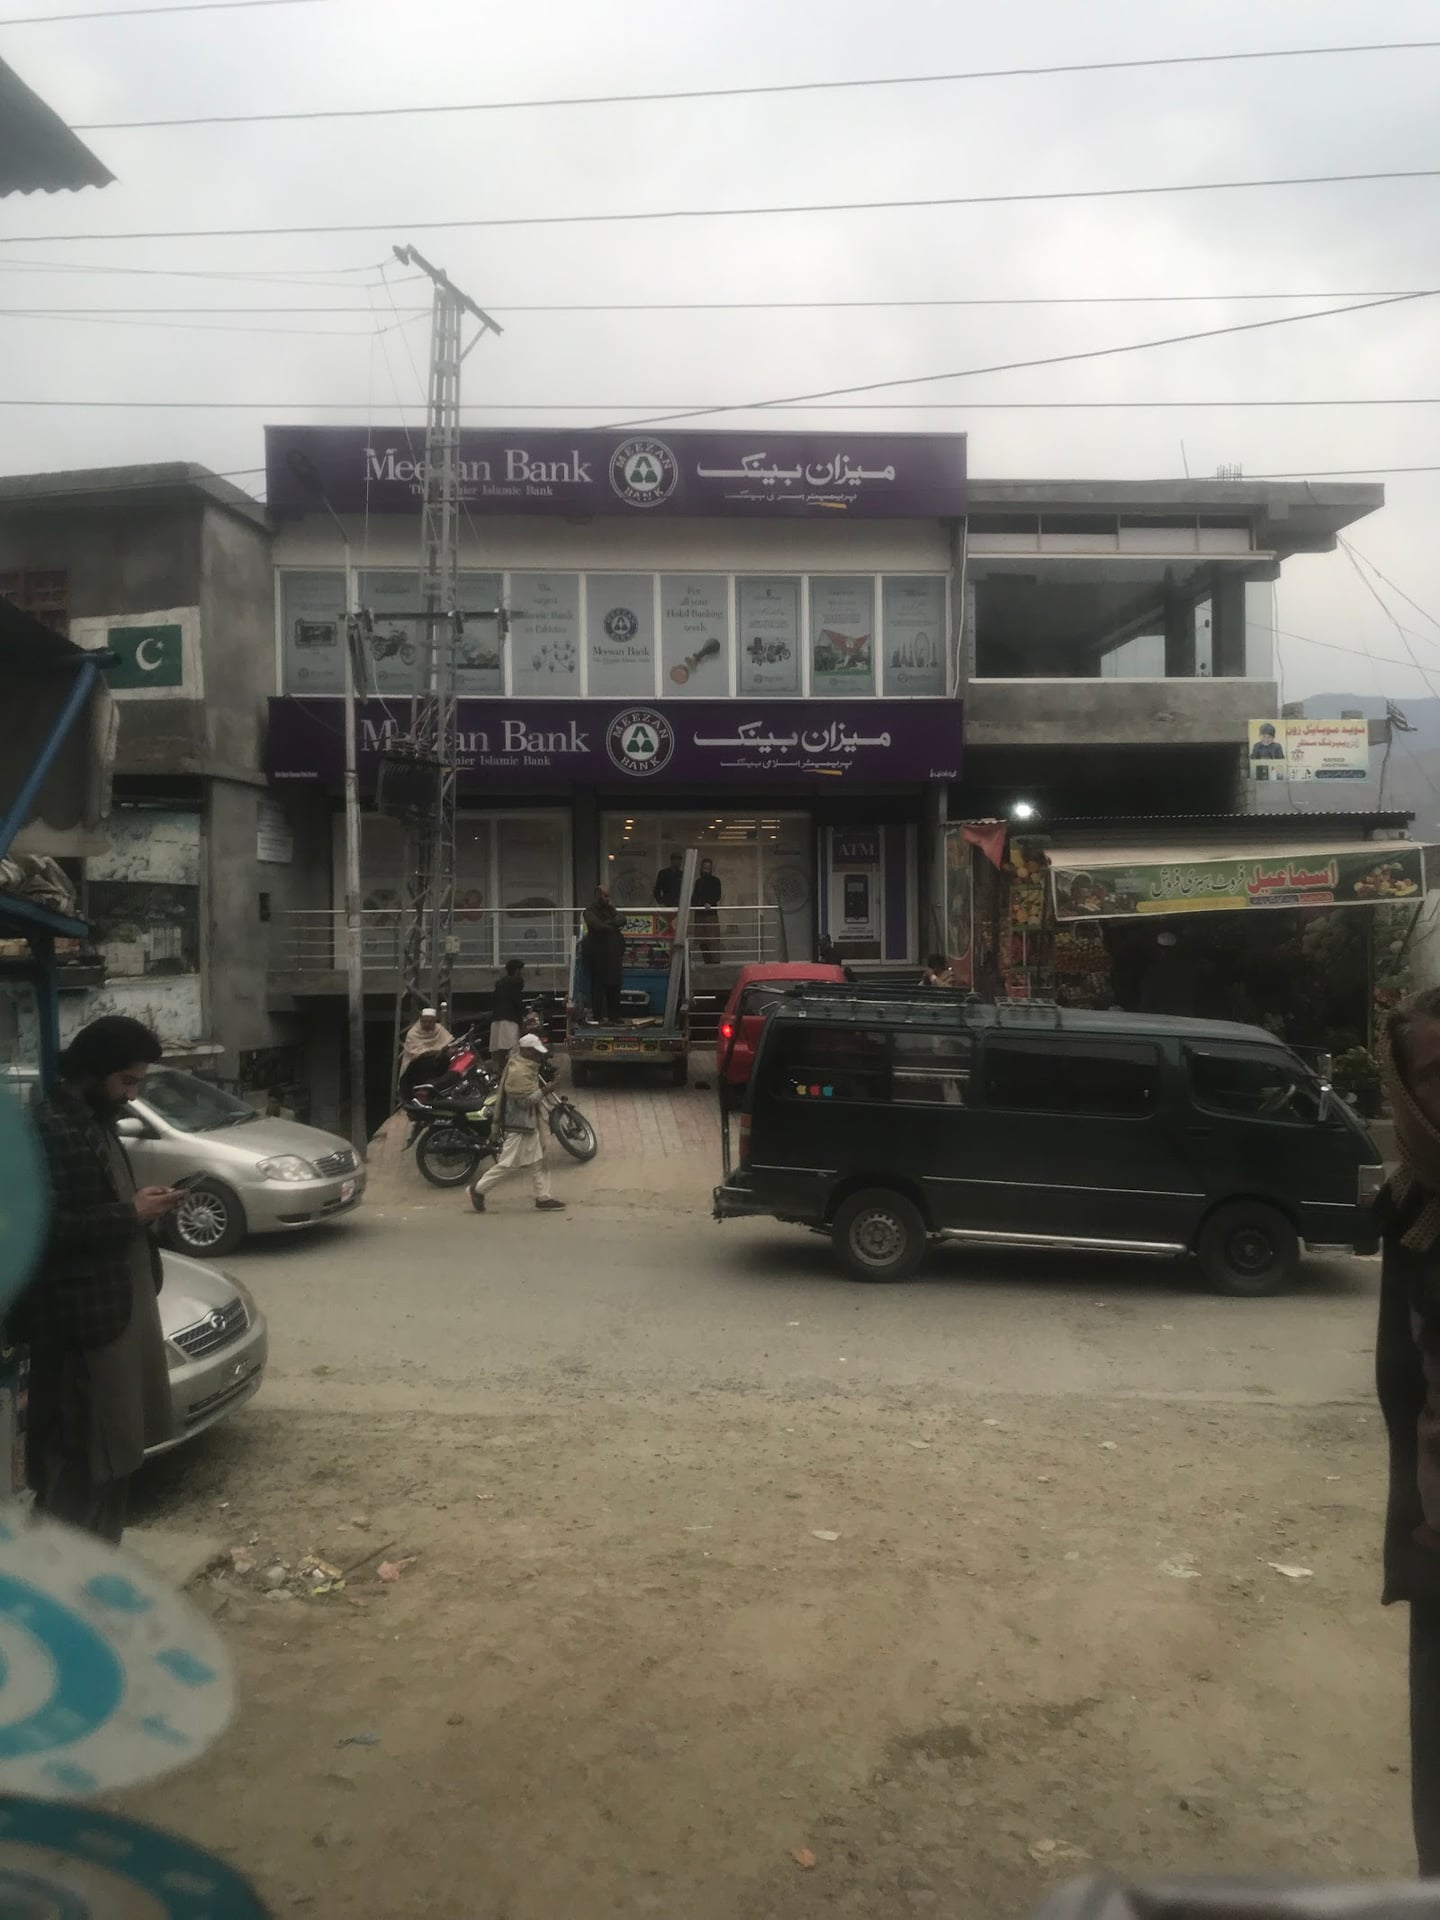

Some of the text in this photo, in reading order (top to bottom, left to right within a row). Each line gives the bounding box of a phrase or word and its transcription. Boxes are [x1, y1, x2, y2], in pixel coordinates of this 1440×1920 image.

[363, 448, 593, 483] Meean Bank
[697, 452, 896, 486] میزان بینک
[482, 485, 521, 496] Islamic
[526, 485, 553, 496] Bank
[502, 720, 590, 753] Bank
[613, 713, 668, 739] MEEZAN
[694, 721, 892, 754] میزان بینک
[480, 755, 519, 766] Islamic
[523, 755, 551, 766] Bank
[621, 756, 661, 770] BANK
[839, 843, 875, 857] ATM
[1246, 858, 1337, 896] اسماعیل
